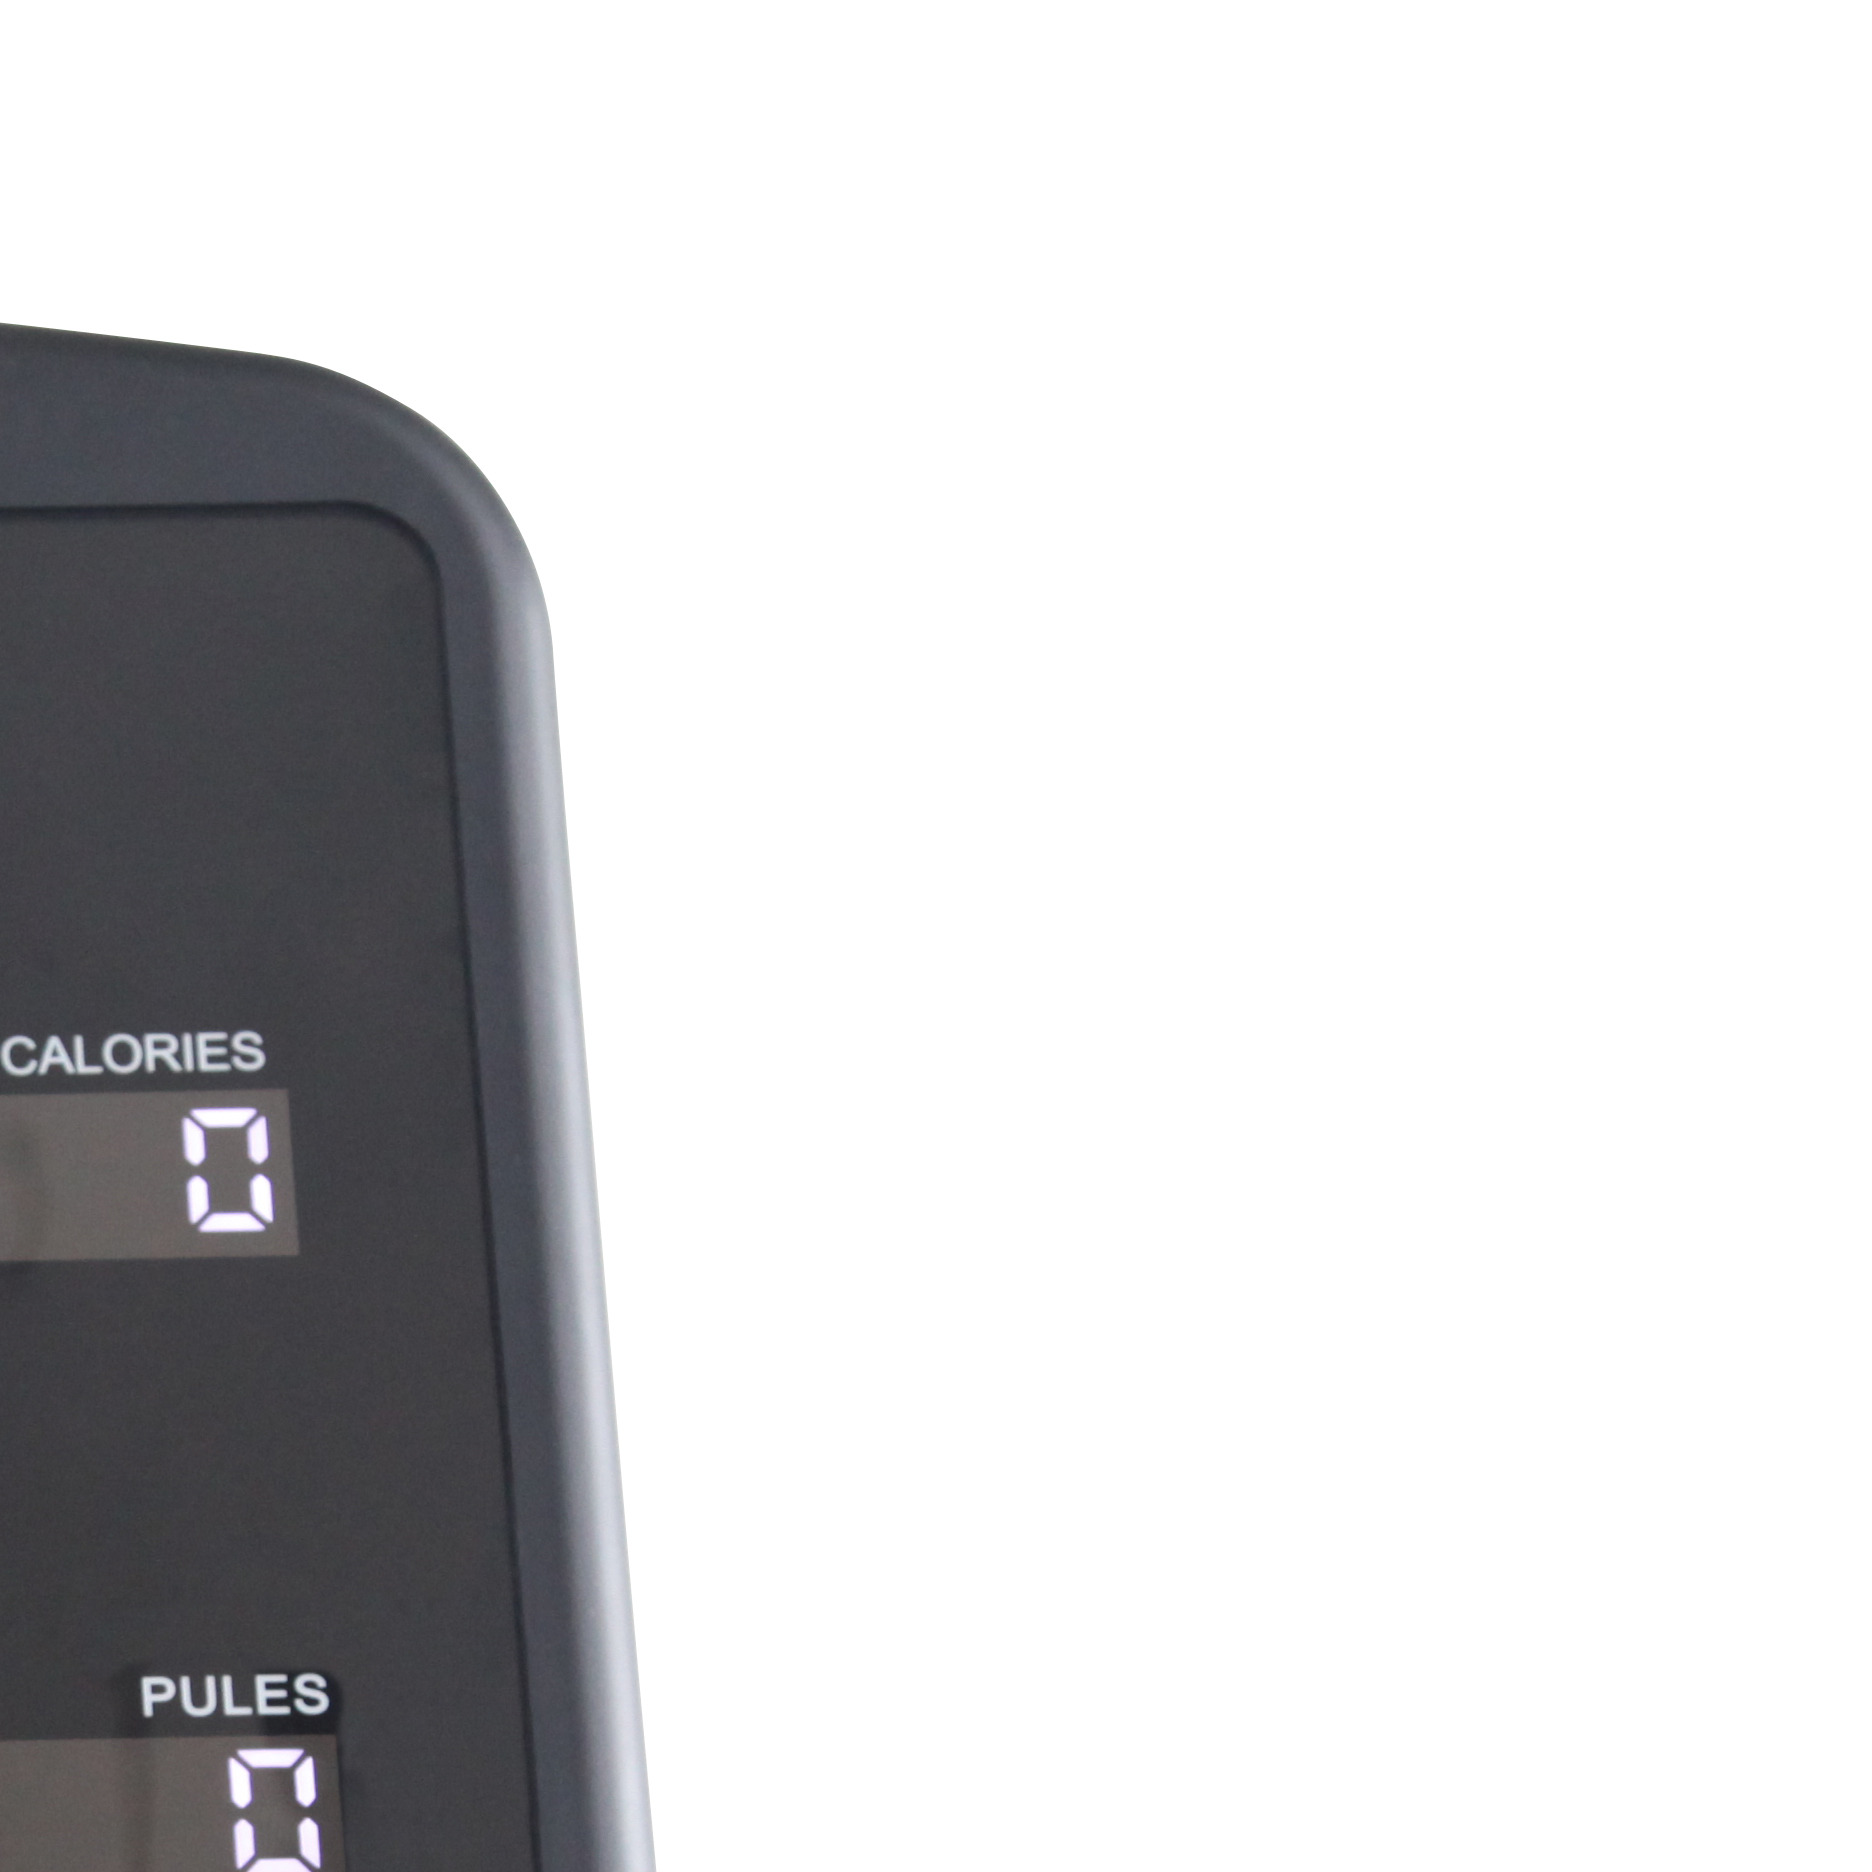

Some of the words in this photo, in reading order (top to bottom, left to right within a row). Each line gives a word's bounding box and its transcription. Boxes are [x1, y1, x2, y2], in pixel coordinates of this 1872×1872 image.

[0, 1029, 267, 1077] CALORIES
[181, 1106, 275, 1234] 0
[140, 1672, 330, 1718] PULES
